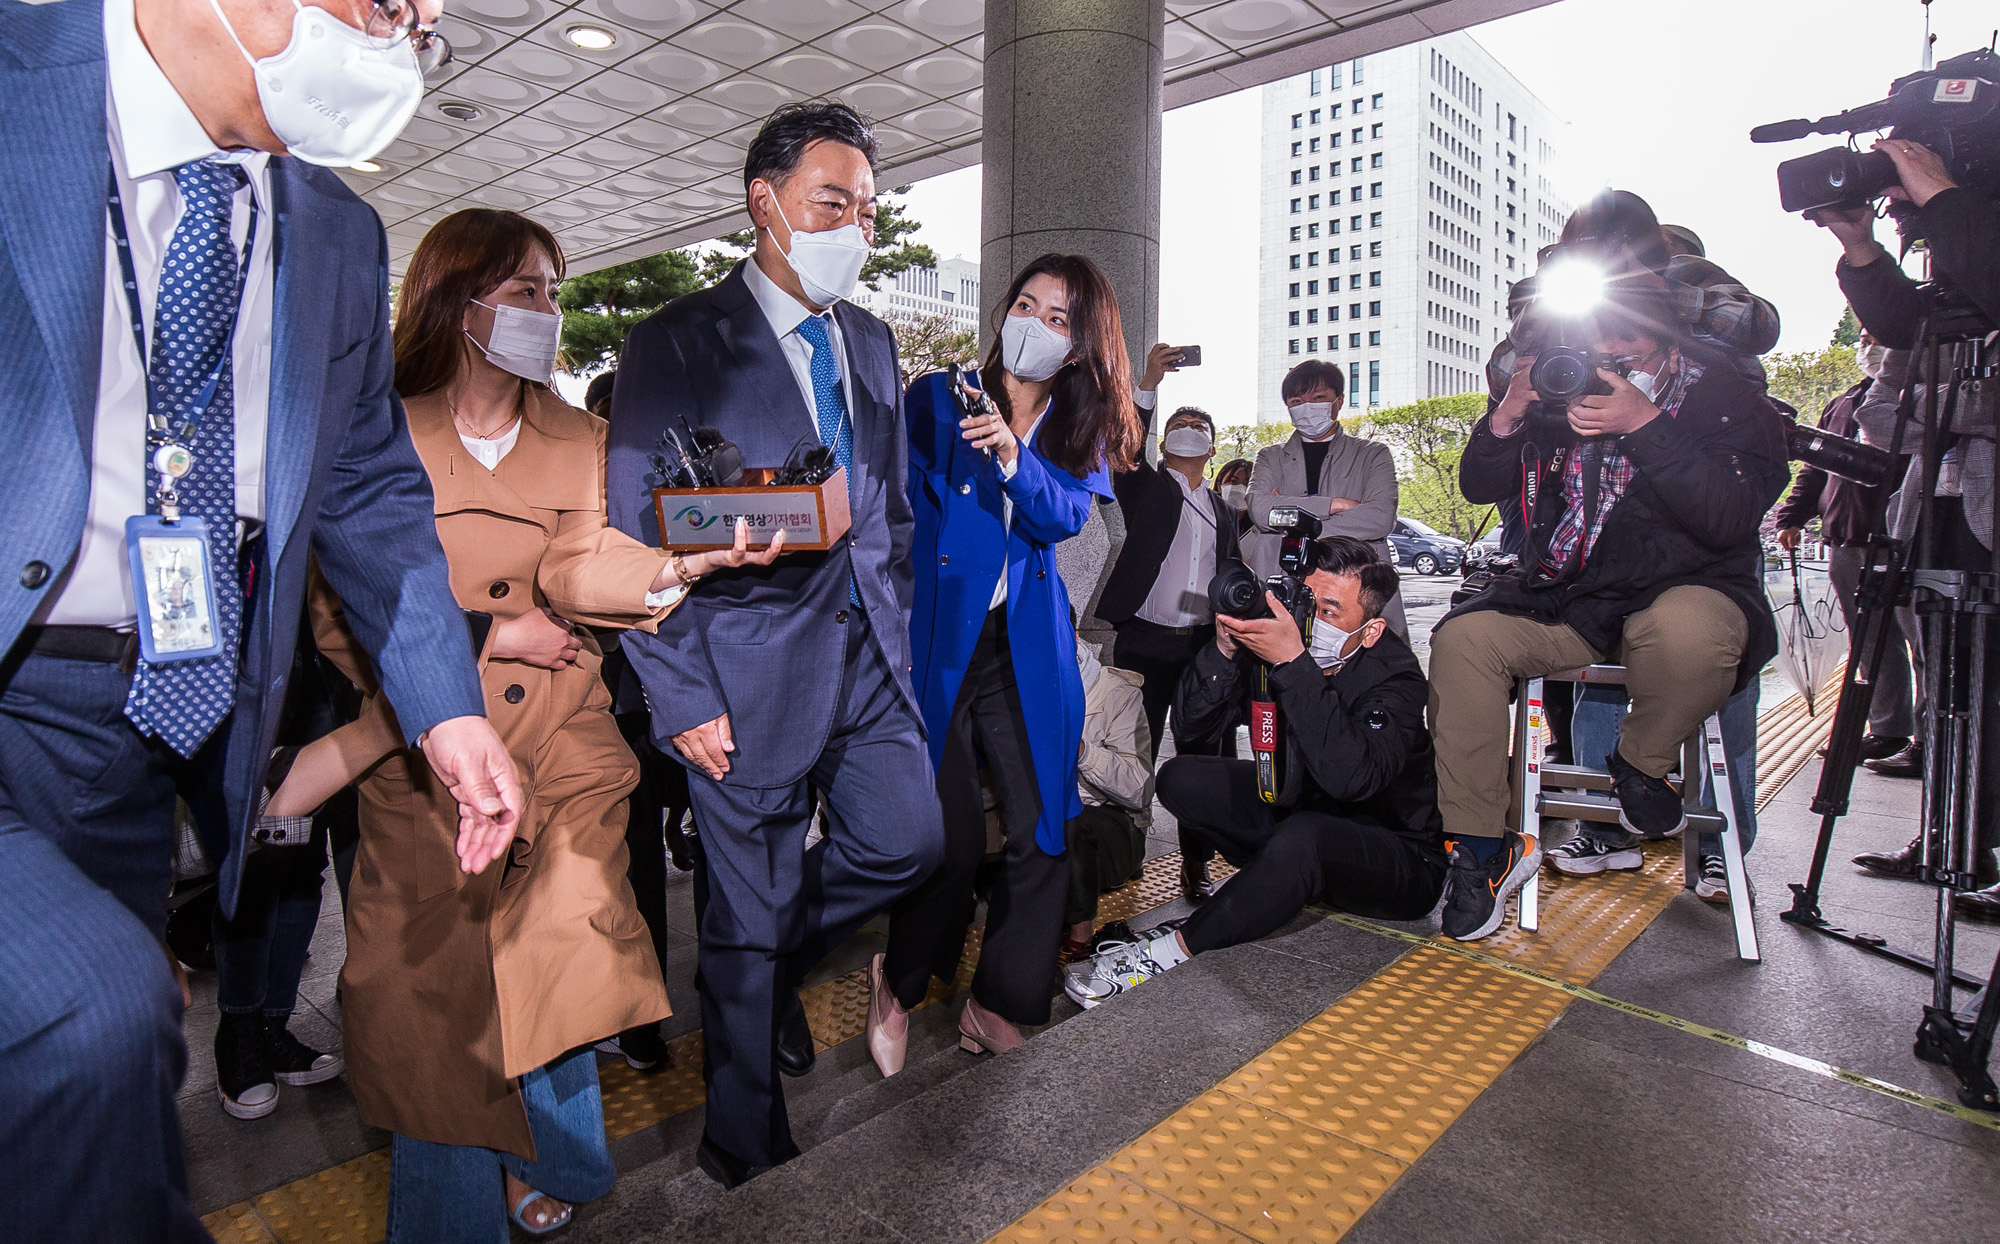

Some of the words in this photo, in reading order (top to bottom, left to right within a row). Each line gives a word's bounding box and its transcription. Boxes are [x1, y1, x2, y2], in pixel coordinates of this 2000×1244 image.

[1550, 447, 1566, 472] EOS
[1527, 471, 1536, 507] Canon
[1262, 711, 1273, 744] PRESS
[1601, 998, 1622, 1007] LINE
[1623, 1005, 1661, 1018] PHOTO
[1712, 1033, 1735, 1042] LINE
